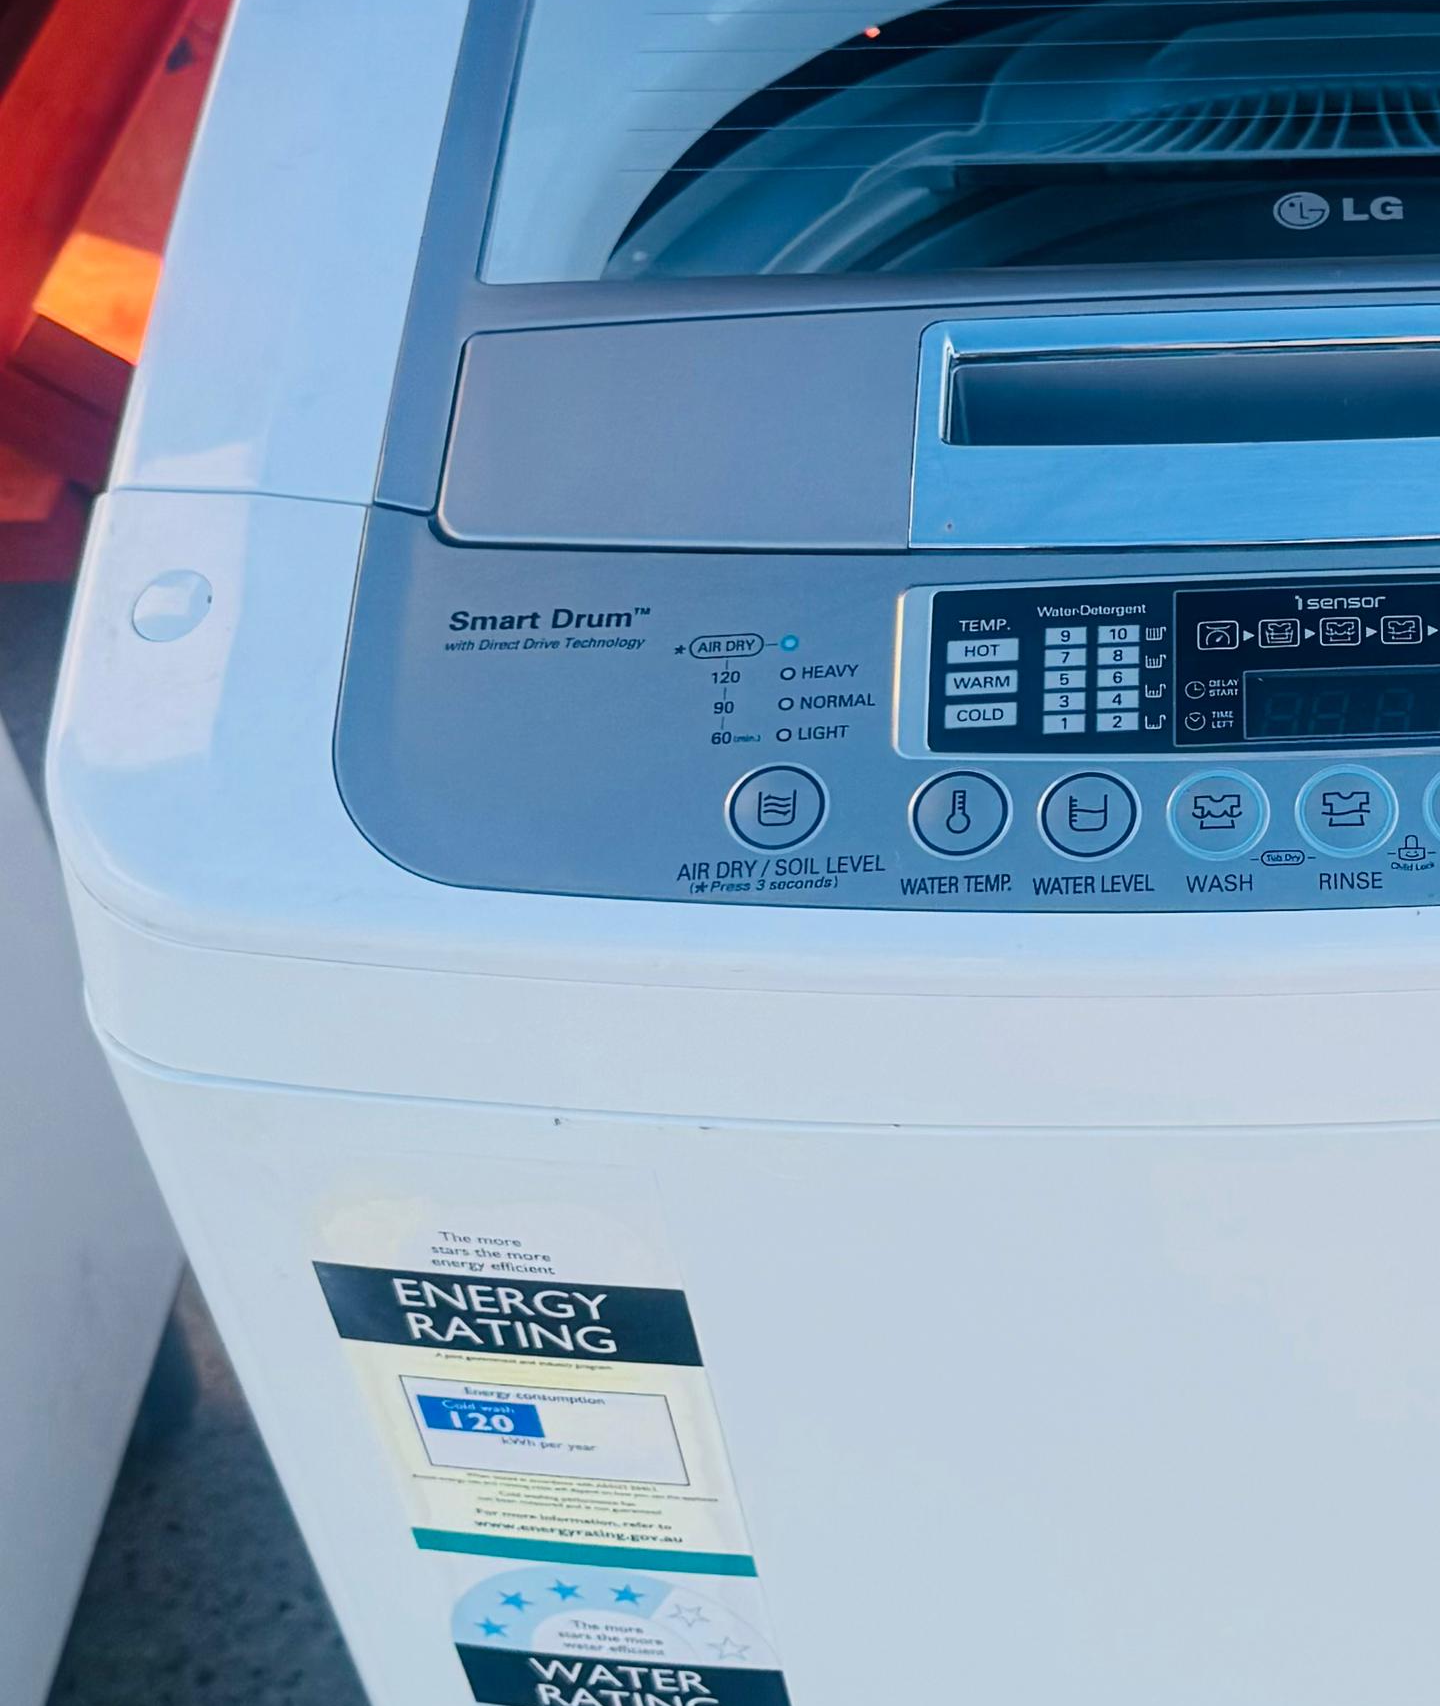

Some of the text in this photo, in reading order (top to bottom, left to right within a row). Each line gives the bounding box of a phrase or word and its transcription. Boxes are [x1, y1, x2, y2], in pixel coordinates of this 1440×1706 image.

[1342, 195, 1404, 221] LG
[1306, 596, 1387, 610] sensor
[449, 611, 541, 631] Smart
[959, 619, 1011, 632] TEMP.
[1060, 628, 1128, 642] 9 10
[445, 636, 646, 652] with Direct Drive Technology
[698, 639, 756, 653] AIR DRY
[964, 644, 1000, 657] HOT
[1061, 650, 1123, 664] 7 8
[711, 670, 741, 684] 120
[801, 664, 859, 679] HEAVY
[1059, 672, 1122, 685] 5 6
[953, 675, 1010, 690] WARM
[1209, 679, 1239, 688] DELAY
[1208, 688, 1239, 697] START
[713, 701, 734, 715] 90
[800, 693, 876, 709] NORMAL
[1059, 693, 1122, 708] 3 4
[956, 708, 1004, 722] COLD
[1212, 710, 1234, 719] TIME
[1061, 716, 1122, 730] 1 2
[1211, 720, 1234, 729] LEFT
[798, 725, 850, 740] LIGHT
[1266, 854, 1301, 863] Tub Dry
[676, 854, 886, 881] AIR DRY / SOIL LEVEL
[756, 879, 766, 891] 3
[900, 874, 1012, 895] WATER TEMP.
[1033, 874, 1155, 896] WATER LEVEL
[1187, 874, 1253, 893] WASH
[1319, 872, 1383, 891] RINSE
[438, 1231, 521, 1247] The more
[431, 1245, 551, 1262] stars the more
[431, 1258, 556, 1275] energy efficient
[393, 1278, 607, 1321] ENERGY
[404, 1312, 618, 1355] RATING
[464, 1386, 607, 1406] Energy consumption
[442, 1399, 515, 1414] Cold wash
[450, 1410, 515, 1434] 120
[501, 1436, 597, 1452] kWh per year
[528, 1656, 712, 1695] WATER
